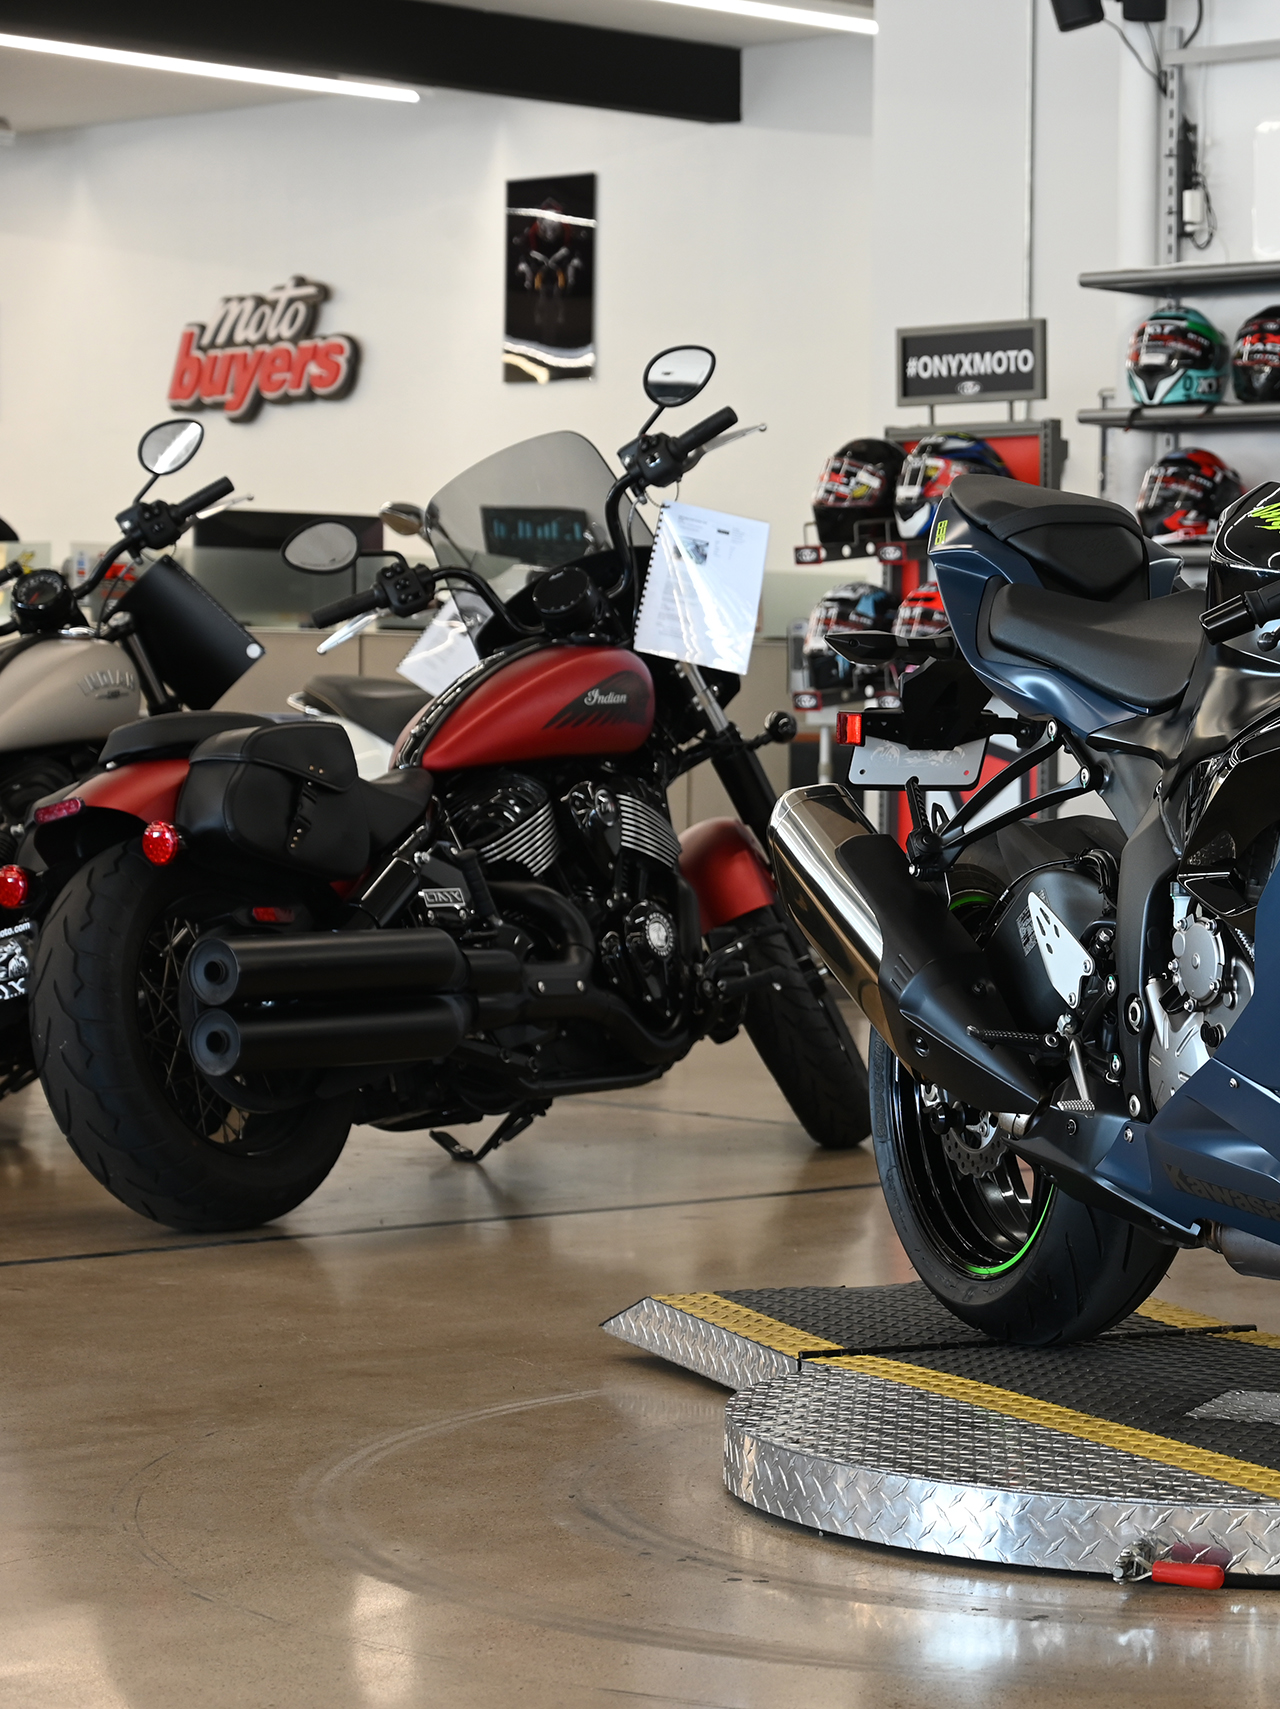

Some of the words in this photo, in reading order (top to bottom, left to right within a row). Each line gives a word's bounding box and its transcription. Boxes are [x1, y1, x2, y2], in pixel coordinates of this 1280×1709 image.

[166, 327, 349, 414] buyers
[906, 348, 1035, 380] #ONYXMOTO
[583, 688, 627, 706] Indian
[0, 921, 31, 939] oto.com
